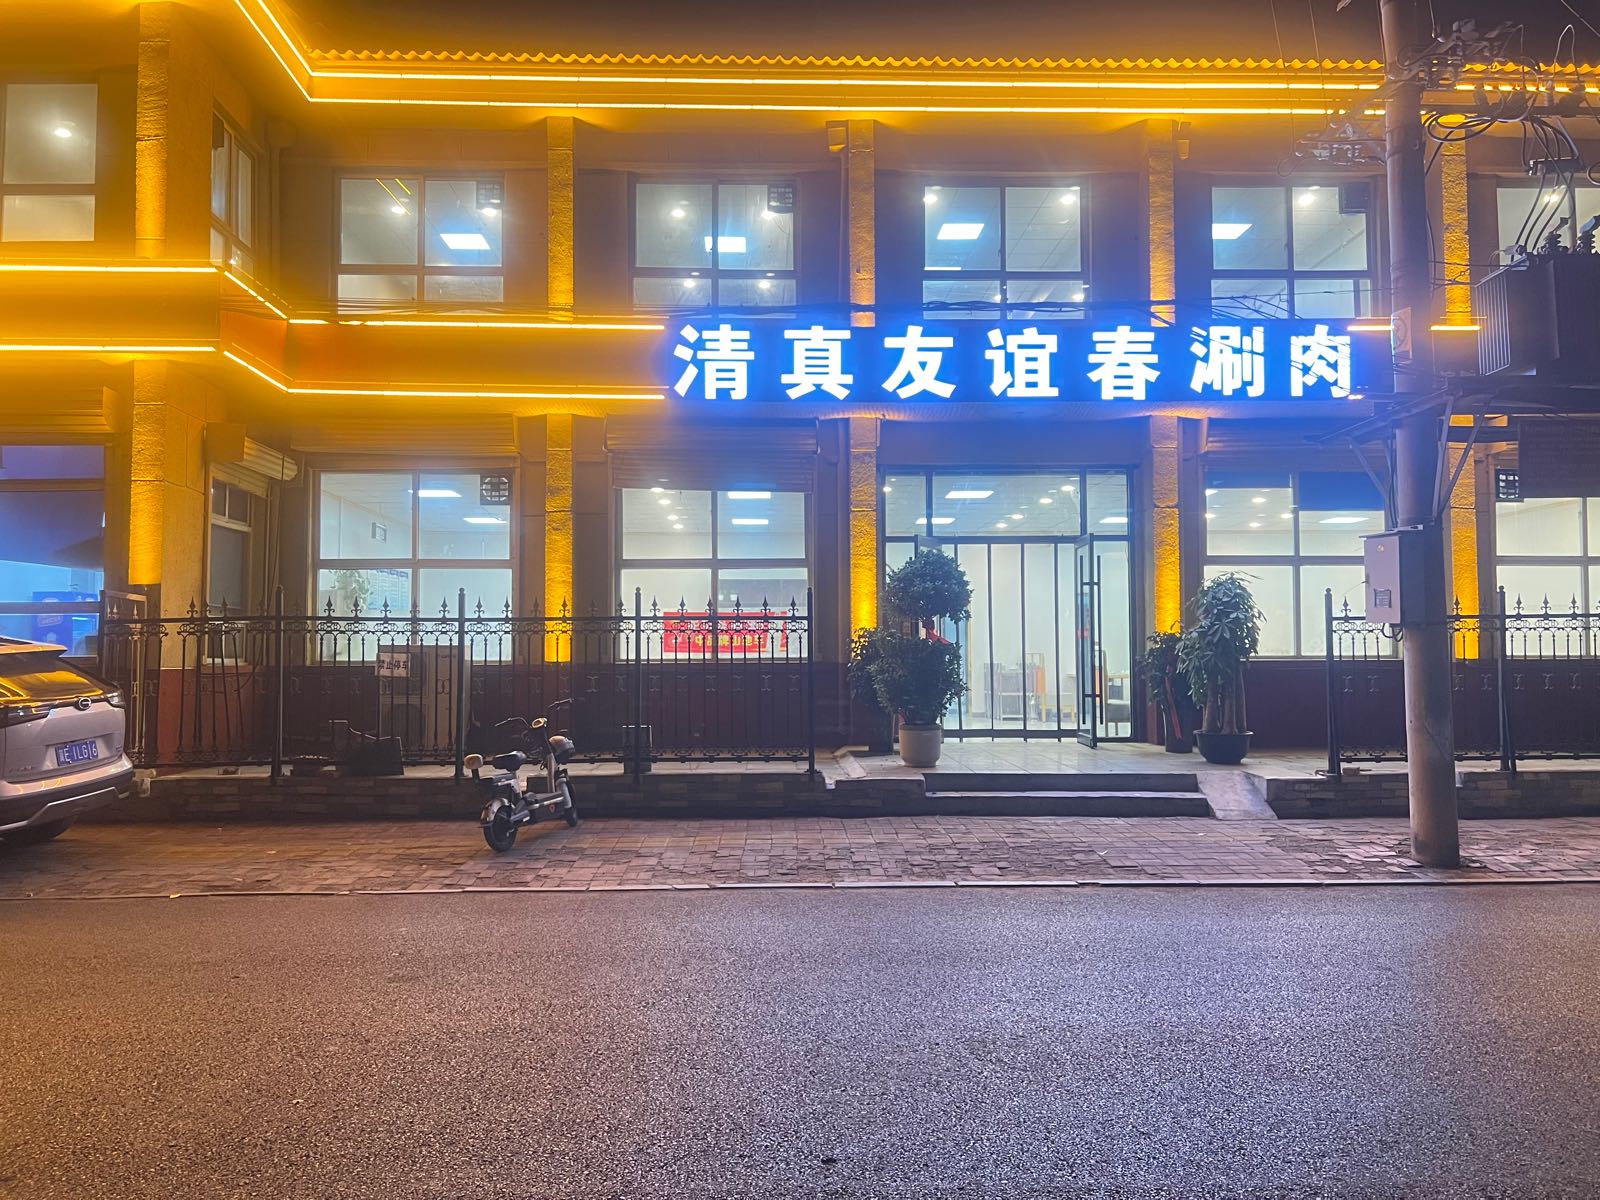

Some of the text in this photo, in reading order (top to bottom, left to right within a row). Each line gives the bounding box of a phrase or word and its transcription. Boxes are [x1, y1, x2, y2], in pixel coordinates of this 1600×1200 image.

[674, 325, 1353, 400] 清真友谊春涮肉
[377, 660, 408, 670] 禁止停车
